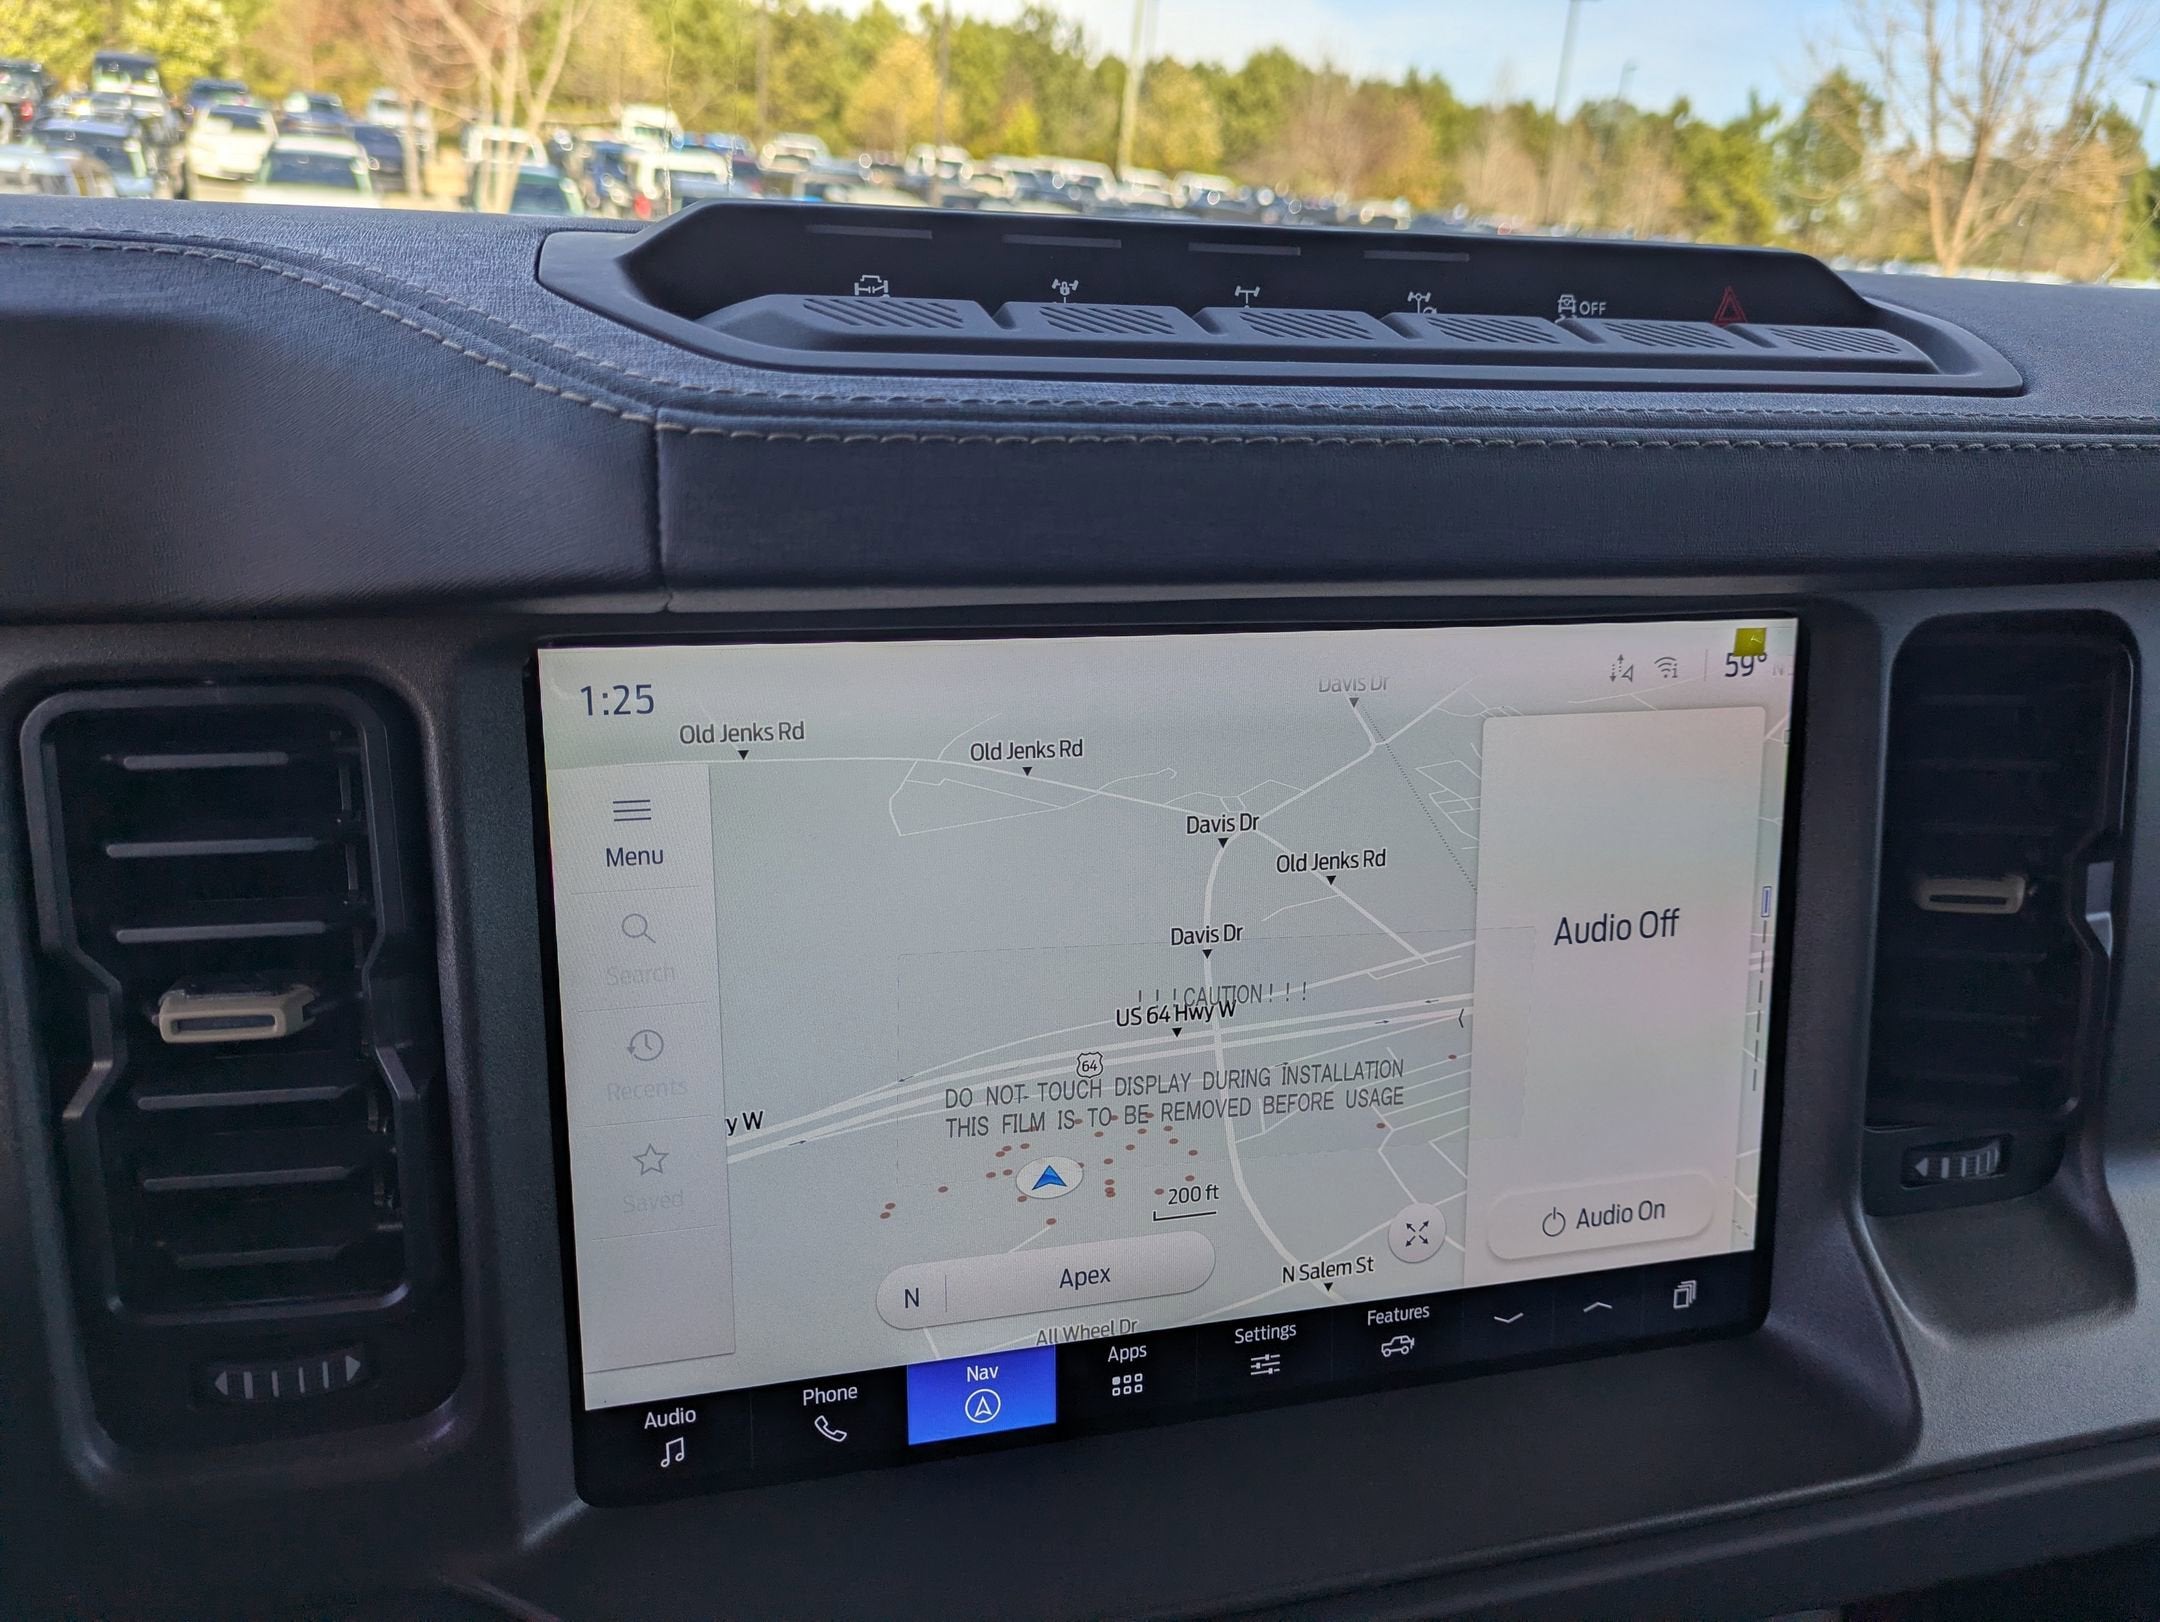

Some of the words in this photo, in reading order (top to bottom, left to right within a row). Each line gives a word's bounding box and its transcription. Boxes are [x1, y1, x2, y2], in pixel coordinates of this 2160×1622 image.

[1579, 301, 1607, 315] OFF
[1725, 652, 1767, 677] 59°
[1319, 675, 1367, 693] Davis
[1370, 675, 1391, 691] Dr
[580, 684, 655, 716] 1:25
[680, 724, 714, 745] Old
[720, 722, 774, 742] Jenks
[779, 721, 805, 740] Rd
[970, 742, 1002, 761] Old
[1006, 740, 1056, 760] Jenks
[1060, 739, 1084, 757] Rd
[1186, 813, 1235, 834] Davis
[1240, 813, 1260, 831] Dr
[605, 846, 664, 867] Menu
[1276, 854, 1306, 872] Old
[1311, 851, 1359, 871] Jenks
[1364, 849, 1386, 867] Rd
[1171, 926, 1219, 945] Davis
[1224, 924, 1243, 941] Dr
[1554, 913, 1631, 946] Audio
[1639, 908, 1680, 938] Off
[607, 965, 675, 986] Search
[1116, 1007, 1142, 1027] US
[1147, 1005, 1171, 1024] 64
[1175, 1004, 1214, 1023] Hwy
[1219, 1000, 1237, 1018] W
[1082, 1060, 1098, 1072] 64
[607, 1079, 688, 1101] Recents
[945, 1088, 973, 1108] DO
[986, 1084, 1026, 1106] NOT
[1037, 1079, 1101, 1102] TOUCH
[1115, 1072, 1191, 1097] DISPLAY
[1203, 1068, 1271, 1091] DURING
[1281, 1059, 1404, 1086] INSTALLATION
[742, 1111, 763, 1130] W
[945, 1115, 989, 1138] THIS
[1002, 1111, 1045, 1134] FILM
[1058, 1109, 1075, 1130] IS
[1087, 1107, 1112, 1127] TO
[1124, 1104, 1149, 1125] BE
[1161, 1097, 1251, 1122] REMOVED
[1263, 1091, 1334, 1114] BEFORE
[1345, 1086, 1404, 1109] USAGE
[623, 1190, 683, 1213] Saved
[1168, 1186, 1201, 1205] 200
[1205, 1184, 1219, 1200] ft
[1576, 1203, 1633, 1229] Audio
[1638, 1200, 1665, 1221] On
[1059, 1266, 1111, 1290] Apex
[1282, 1266, 1295, 1283] N
[1299, 1261, 1352, 1282] Salem
[1355, 1256, 1375, 1275] St
[904, 1288, 920, 1309] N
[1367, 1305, 1430, 1325] Features
[1036, 1328, 1058, 1347] All
[1061, 1321, 1116, 1342] Wheel
[1120, 1318, 1138, 1335] Dr
[1234, 1322, 1297, 1344] Settings
[1108, 1344, 1147, 1364] Apps
[966, 1363, 999, 1383] Nav
[802, 1383, 858, 1406] Phone
[643, 1407, 697, 1429] Audio
